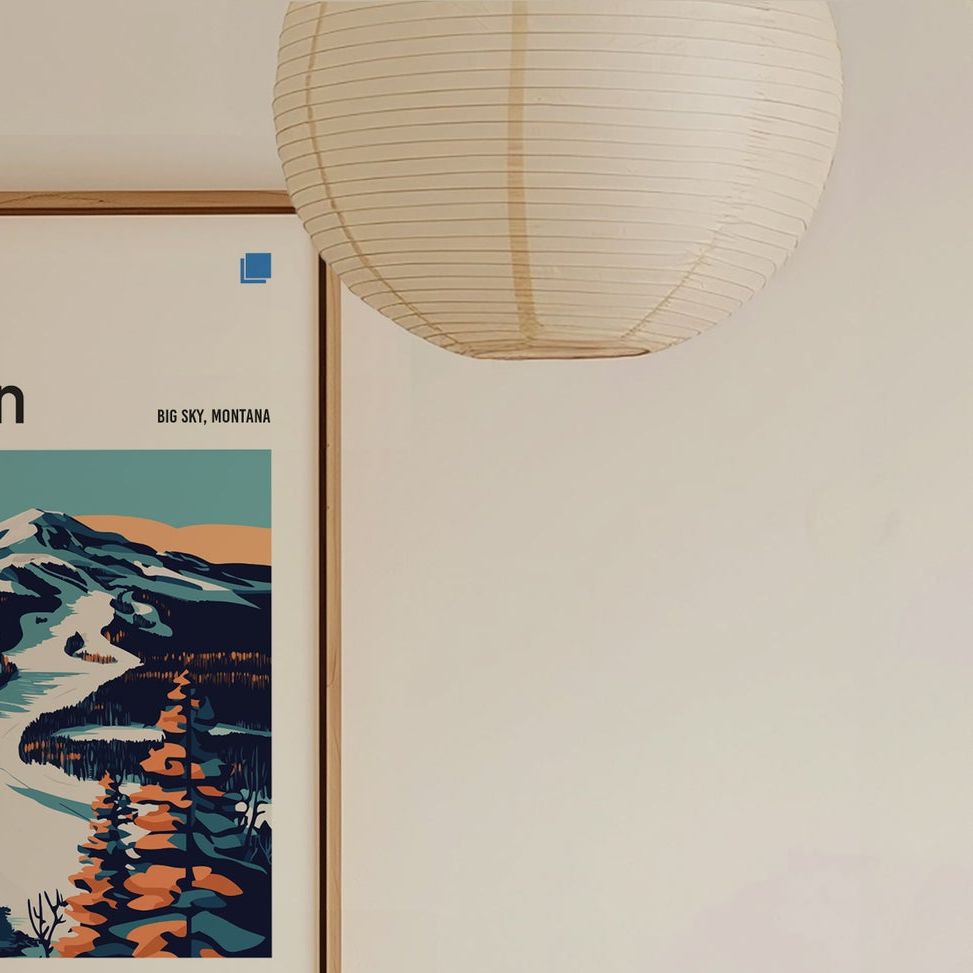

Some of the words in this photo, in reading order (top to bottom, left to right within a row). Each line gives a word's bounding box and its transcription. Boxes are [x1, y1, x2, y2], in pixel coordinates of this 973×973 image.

[157, 409, 177, 424] BIG
[180, 408, 208, 426] SKY,
[211, 408, 271, 424] MONTANA
